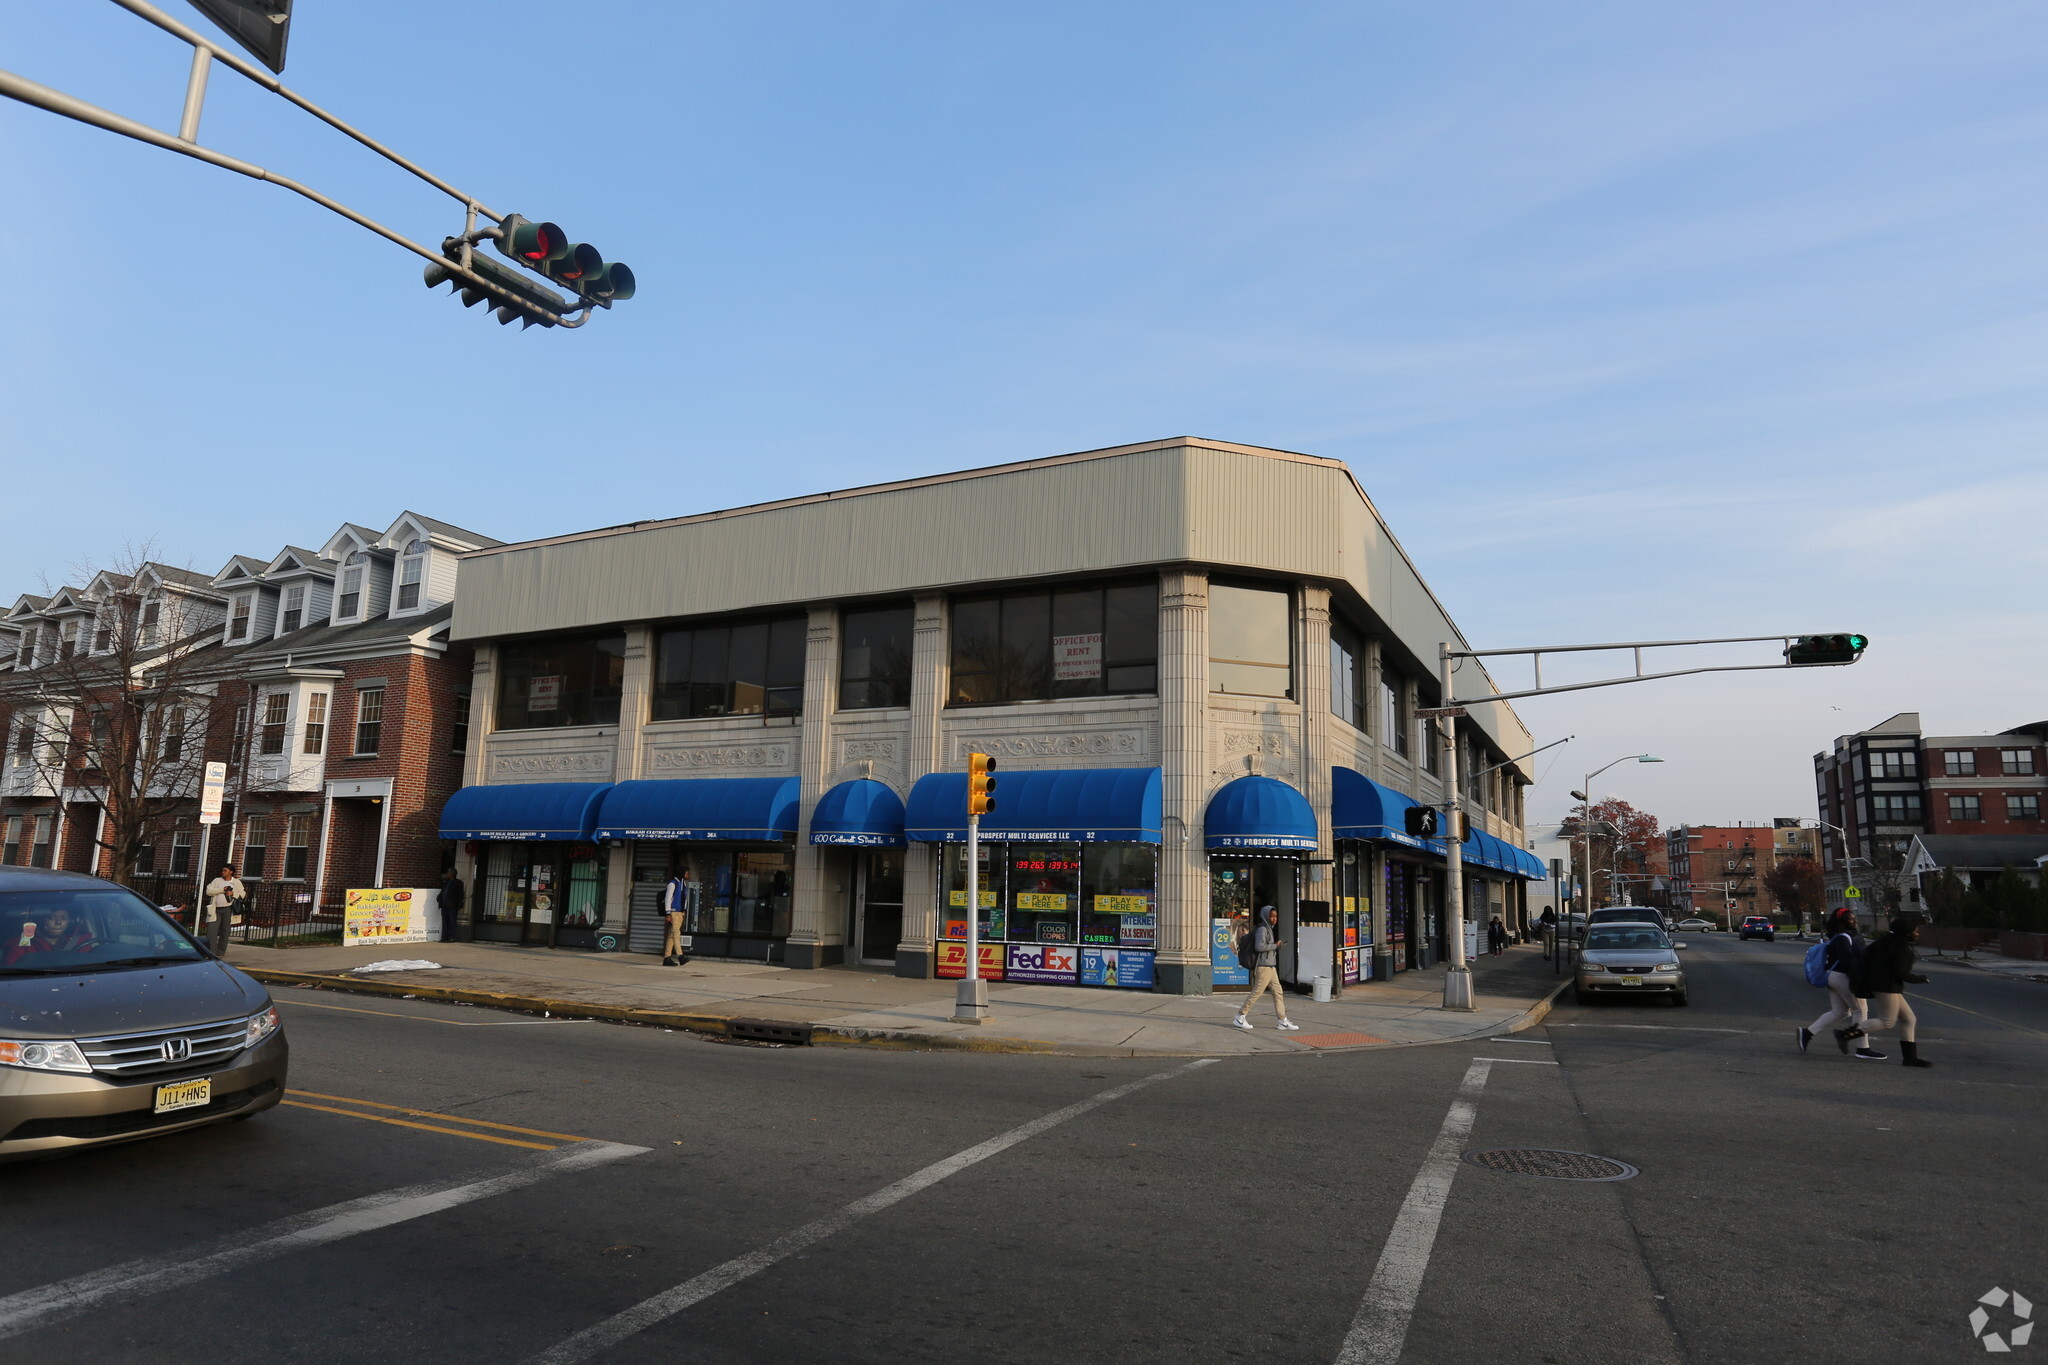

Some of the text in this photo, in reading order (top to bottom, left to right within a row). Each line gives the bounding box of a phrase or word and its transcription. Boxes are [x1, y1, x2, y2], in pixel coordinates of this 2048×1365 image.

[1067, 647, 1090, 656] RENT
[815, 834, 829, 843] 600
[1122, 915, 1154, 925] INTERNET
[1121, 928, 1132, 938] FAX
[1008, 946, 1072, 970] FedEx
[160, 1086, 207, 1106] J11 HNS
